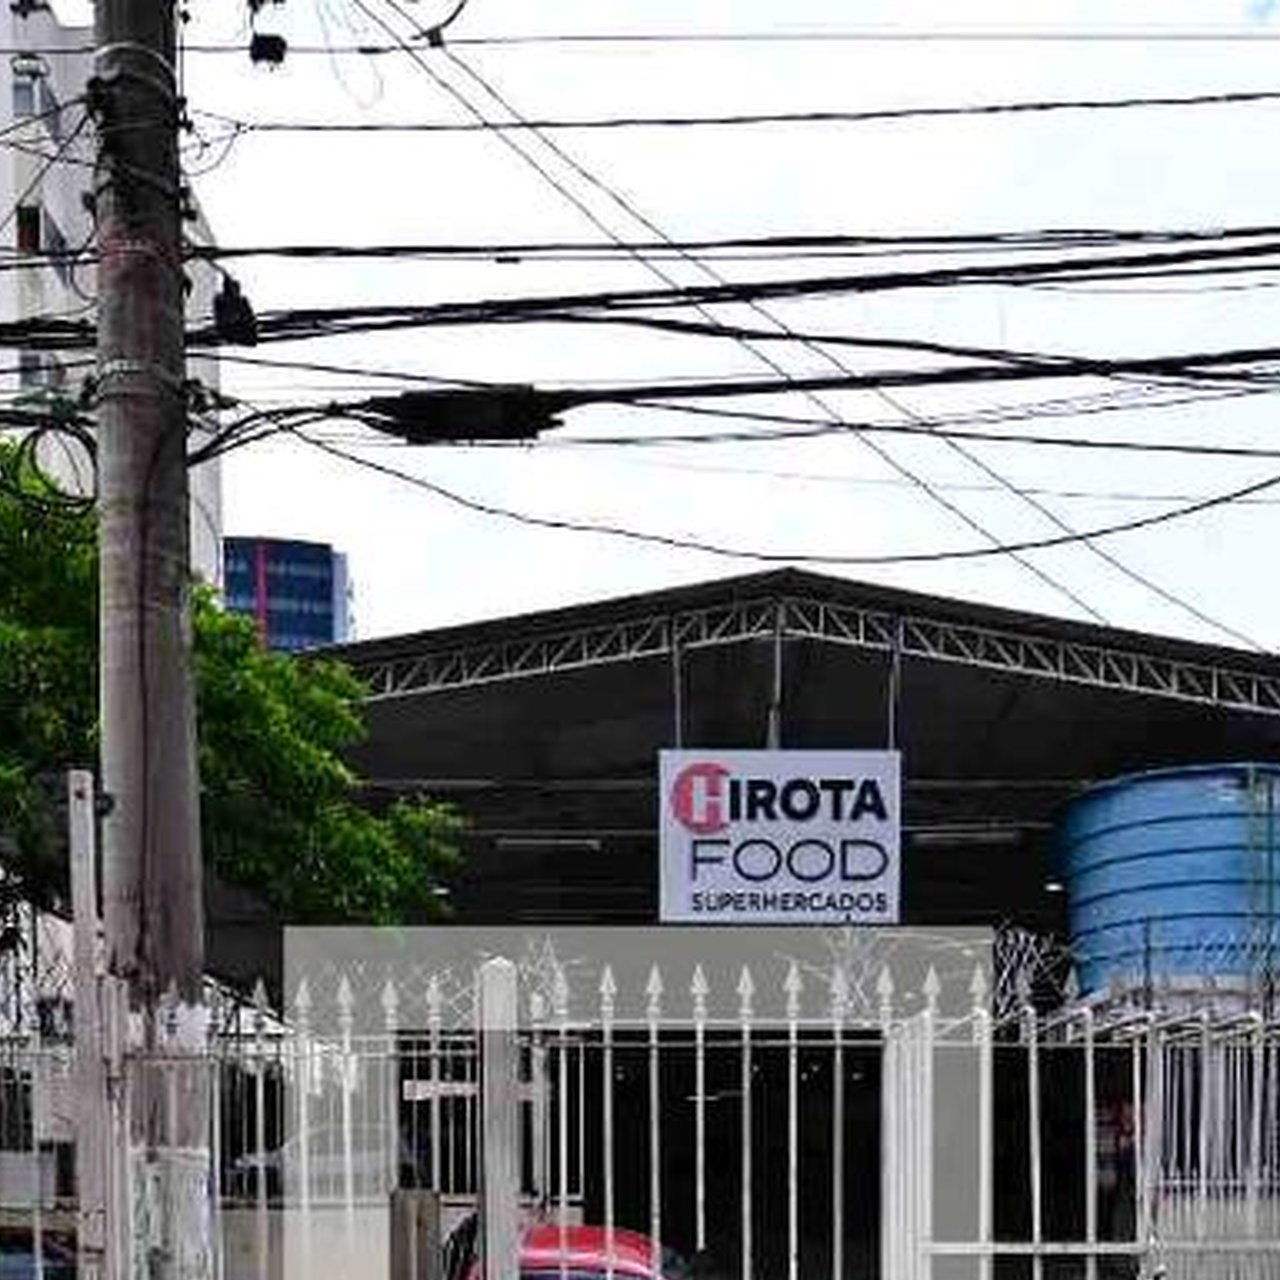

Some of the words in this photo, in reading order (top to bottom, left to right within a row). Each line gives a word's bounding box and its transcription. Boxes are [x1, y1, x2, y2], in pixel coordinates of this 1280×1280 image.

[673, 763, 888, 834] HIROTA
[692, 839, 889, 882] FOOD
[692, 893, 887, 912] SUPERMERCADOS
